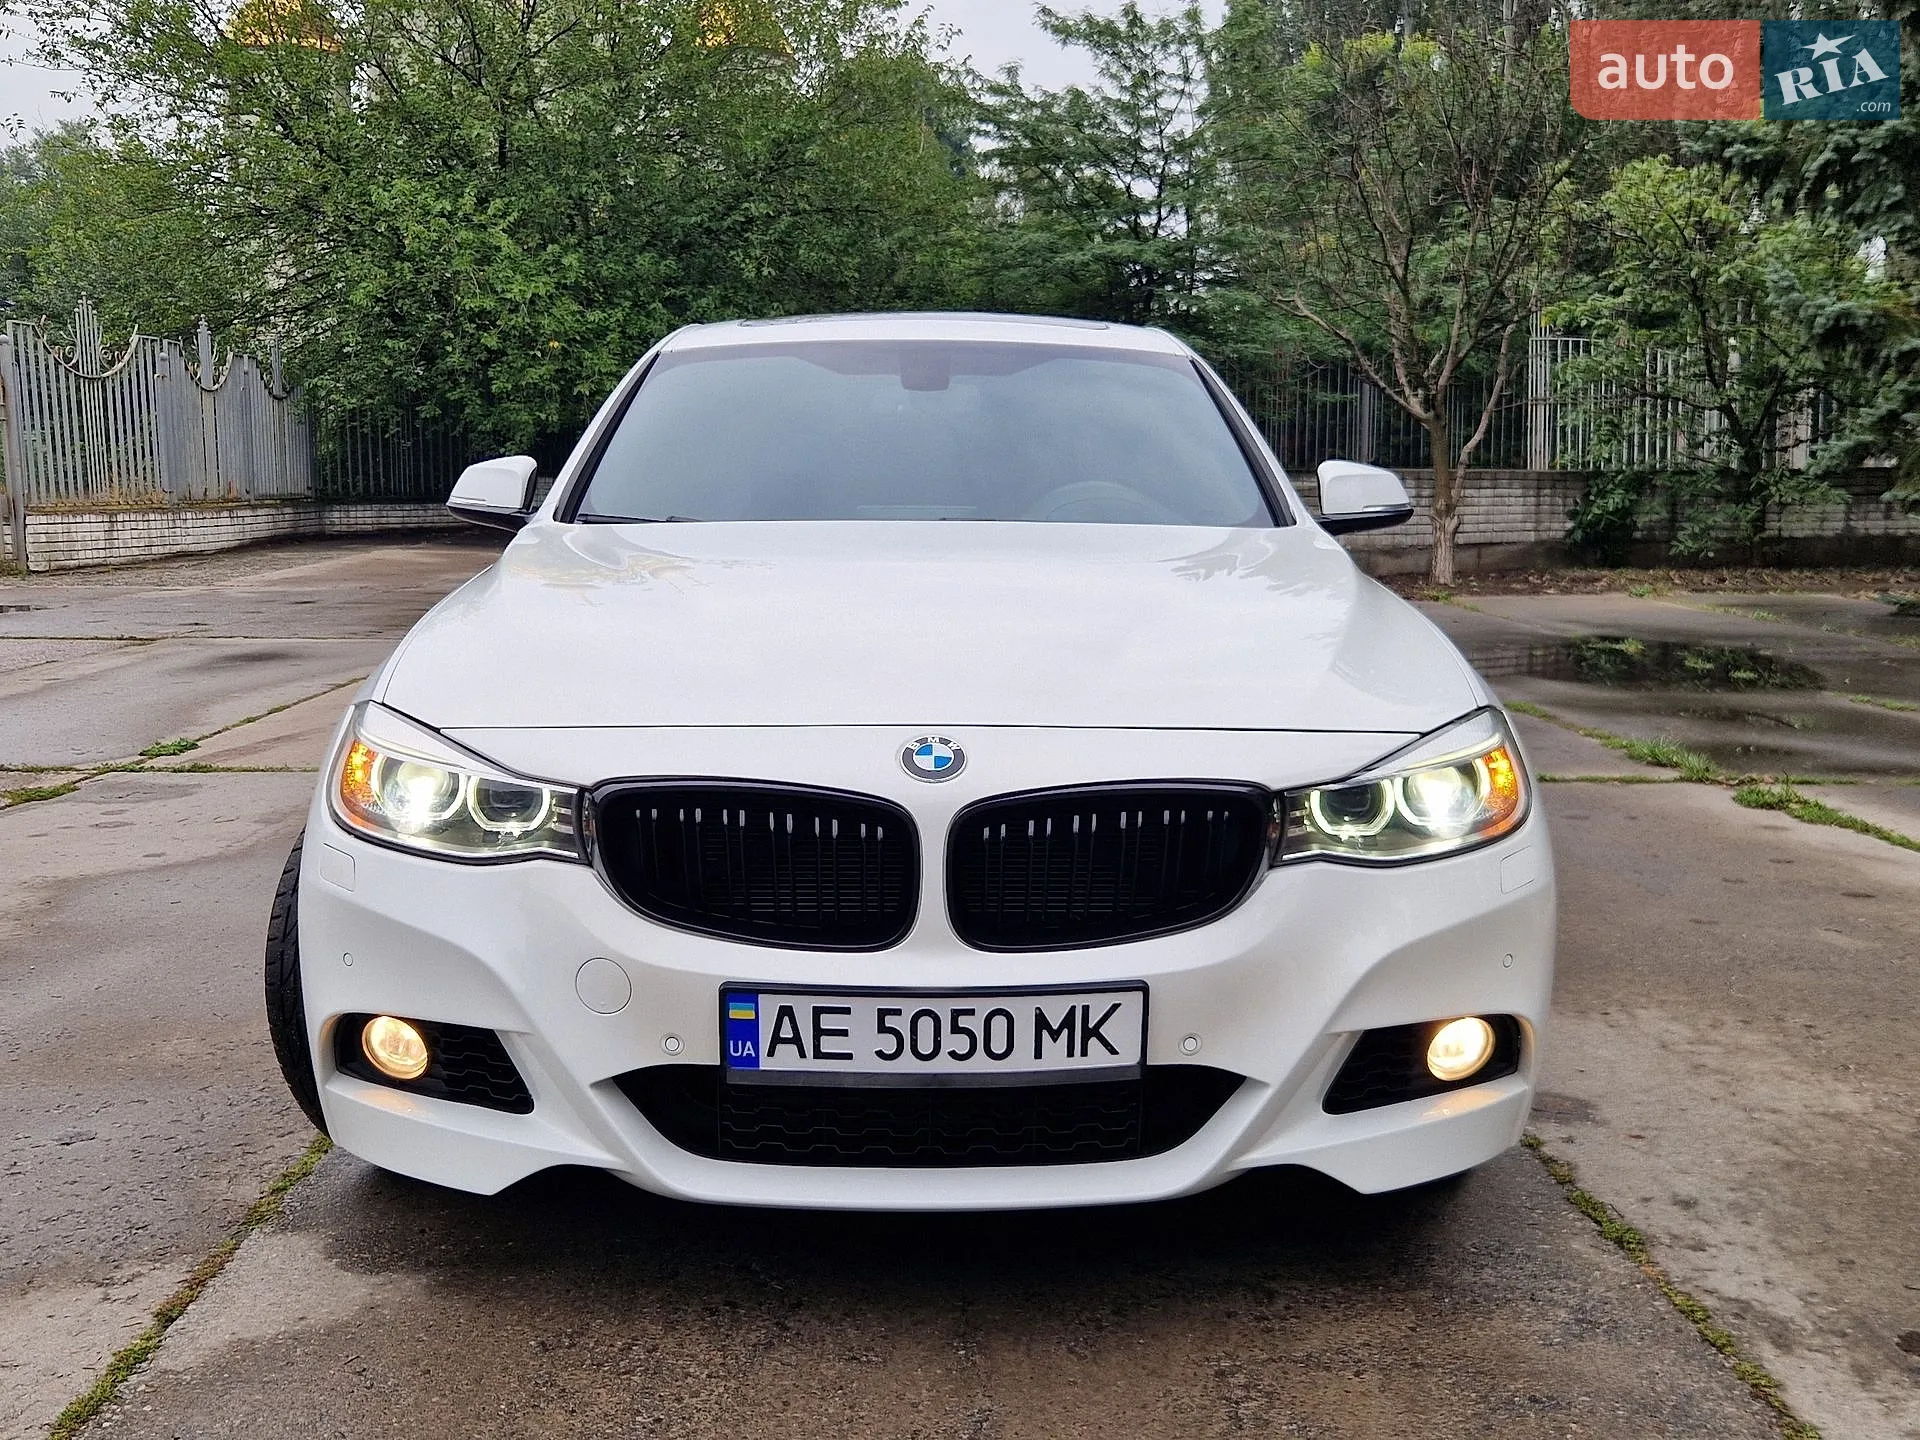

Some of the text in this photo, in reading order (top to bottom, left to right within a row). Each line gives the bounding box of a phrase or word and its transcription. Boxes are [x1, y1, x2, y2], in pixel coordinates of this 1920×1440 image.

[906, 737, 961, 751] BMW
[767, 1003, 1122, 1062] AE 5050 MK
[729, 1040, 755, 1058] UA
